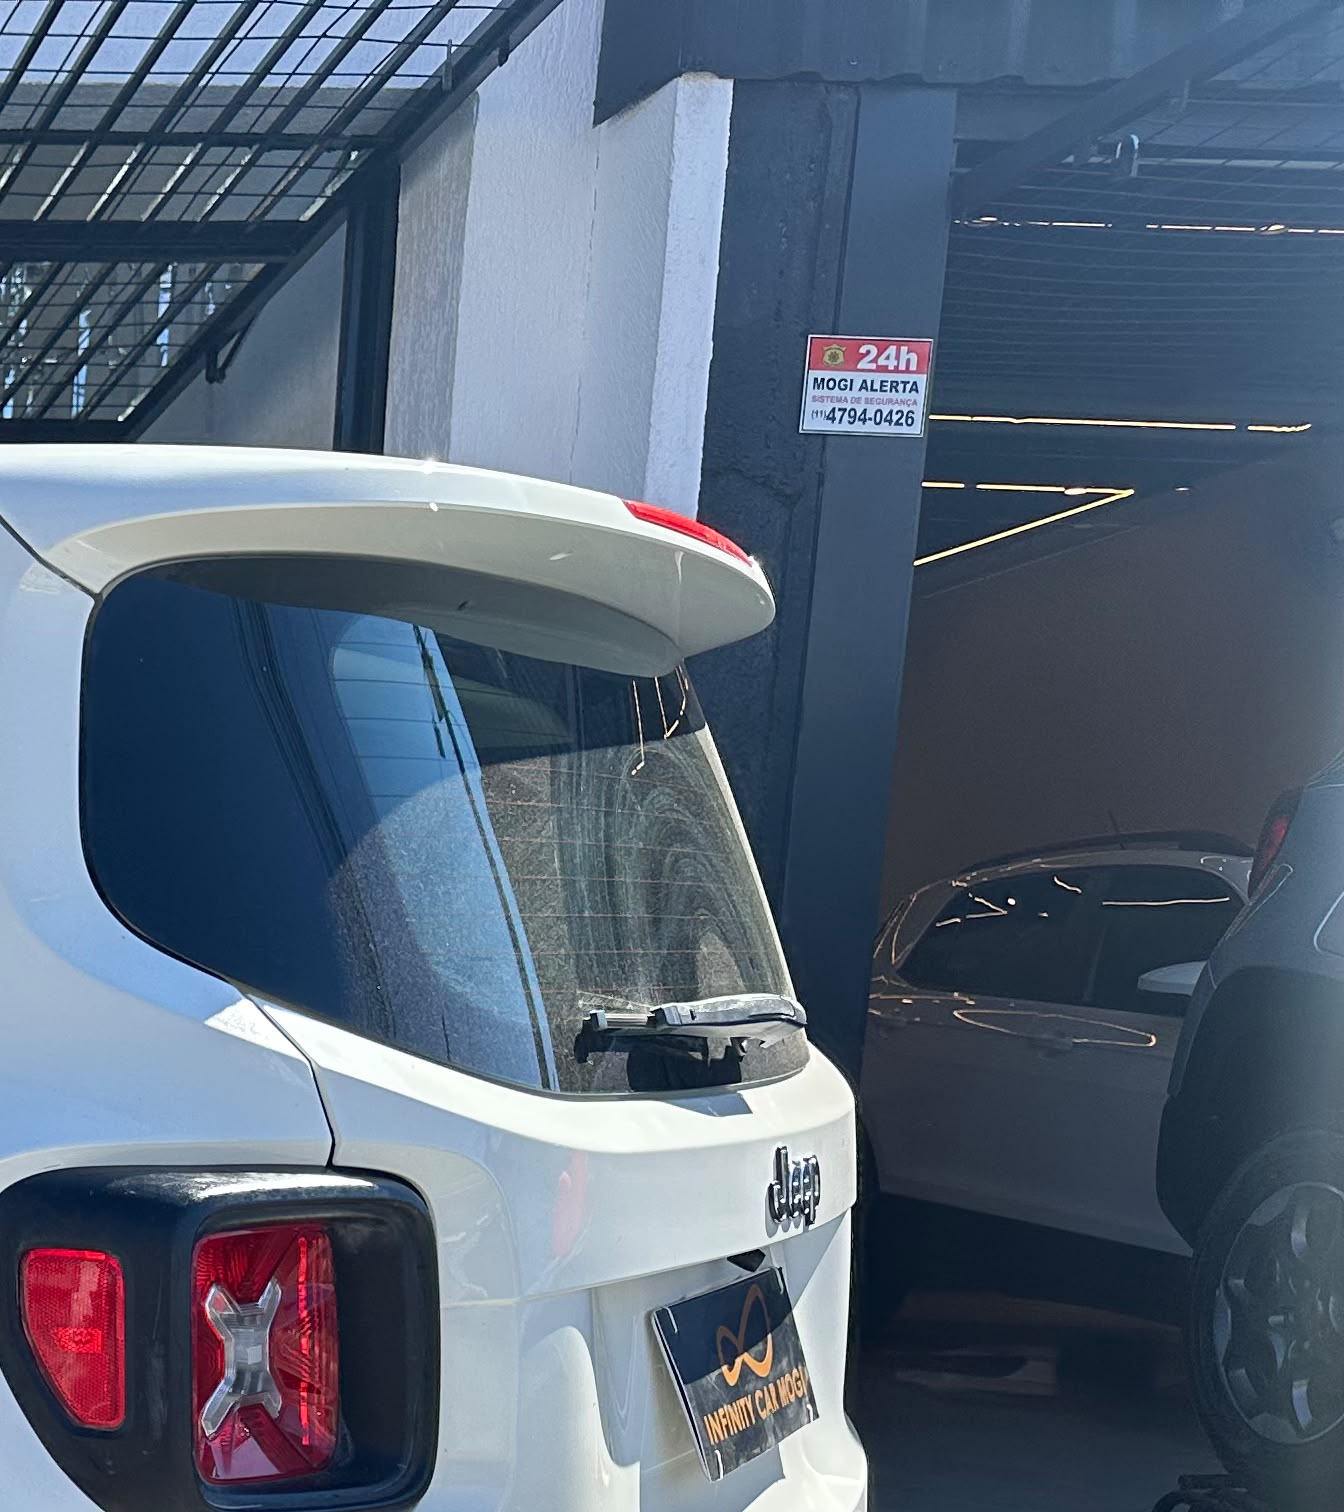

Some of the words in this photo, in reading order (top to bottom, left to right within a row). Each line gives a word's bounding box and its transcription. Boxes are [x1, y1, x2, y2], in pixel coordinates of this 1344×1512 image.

[856, 344, 918, 371] 24h
[812, 377, 853, 391] MOGI
[858, 379, 919, 394] ALERTA
[812, 395, 849, 404] SISTEMA
[850, 396, 862, 404] DE
[864, 397, 918, 407] SEGURANÇA
[767, 1145, 820, 1227] Jeep
[703, 1394, 756, 1446] INFINITY
[755, 1383, 780, 1420] CAR
[777, 1365, 807, 1407] MOGI
